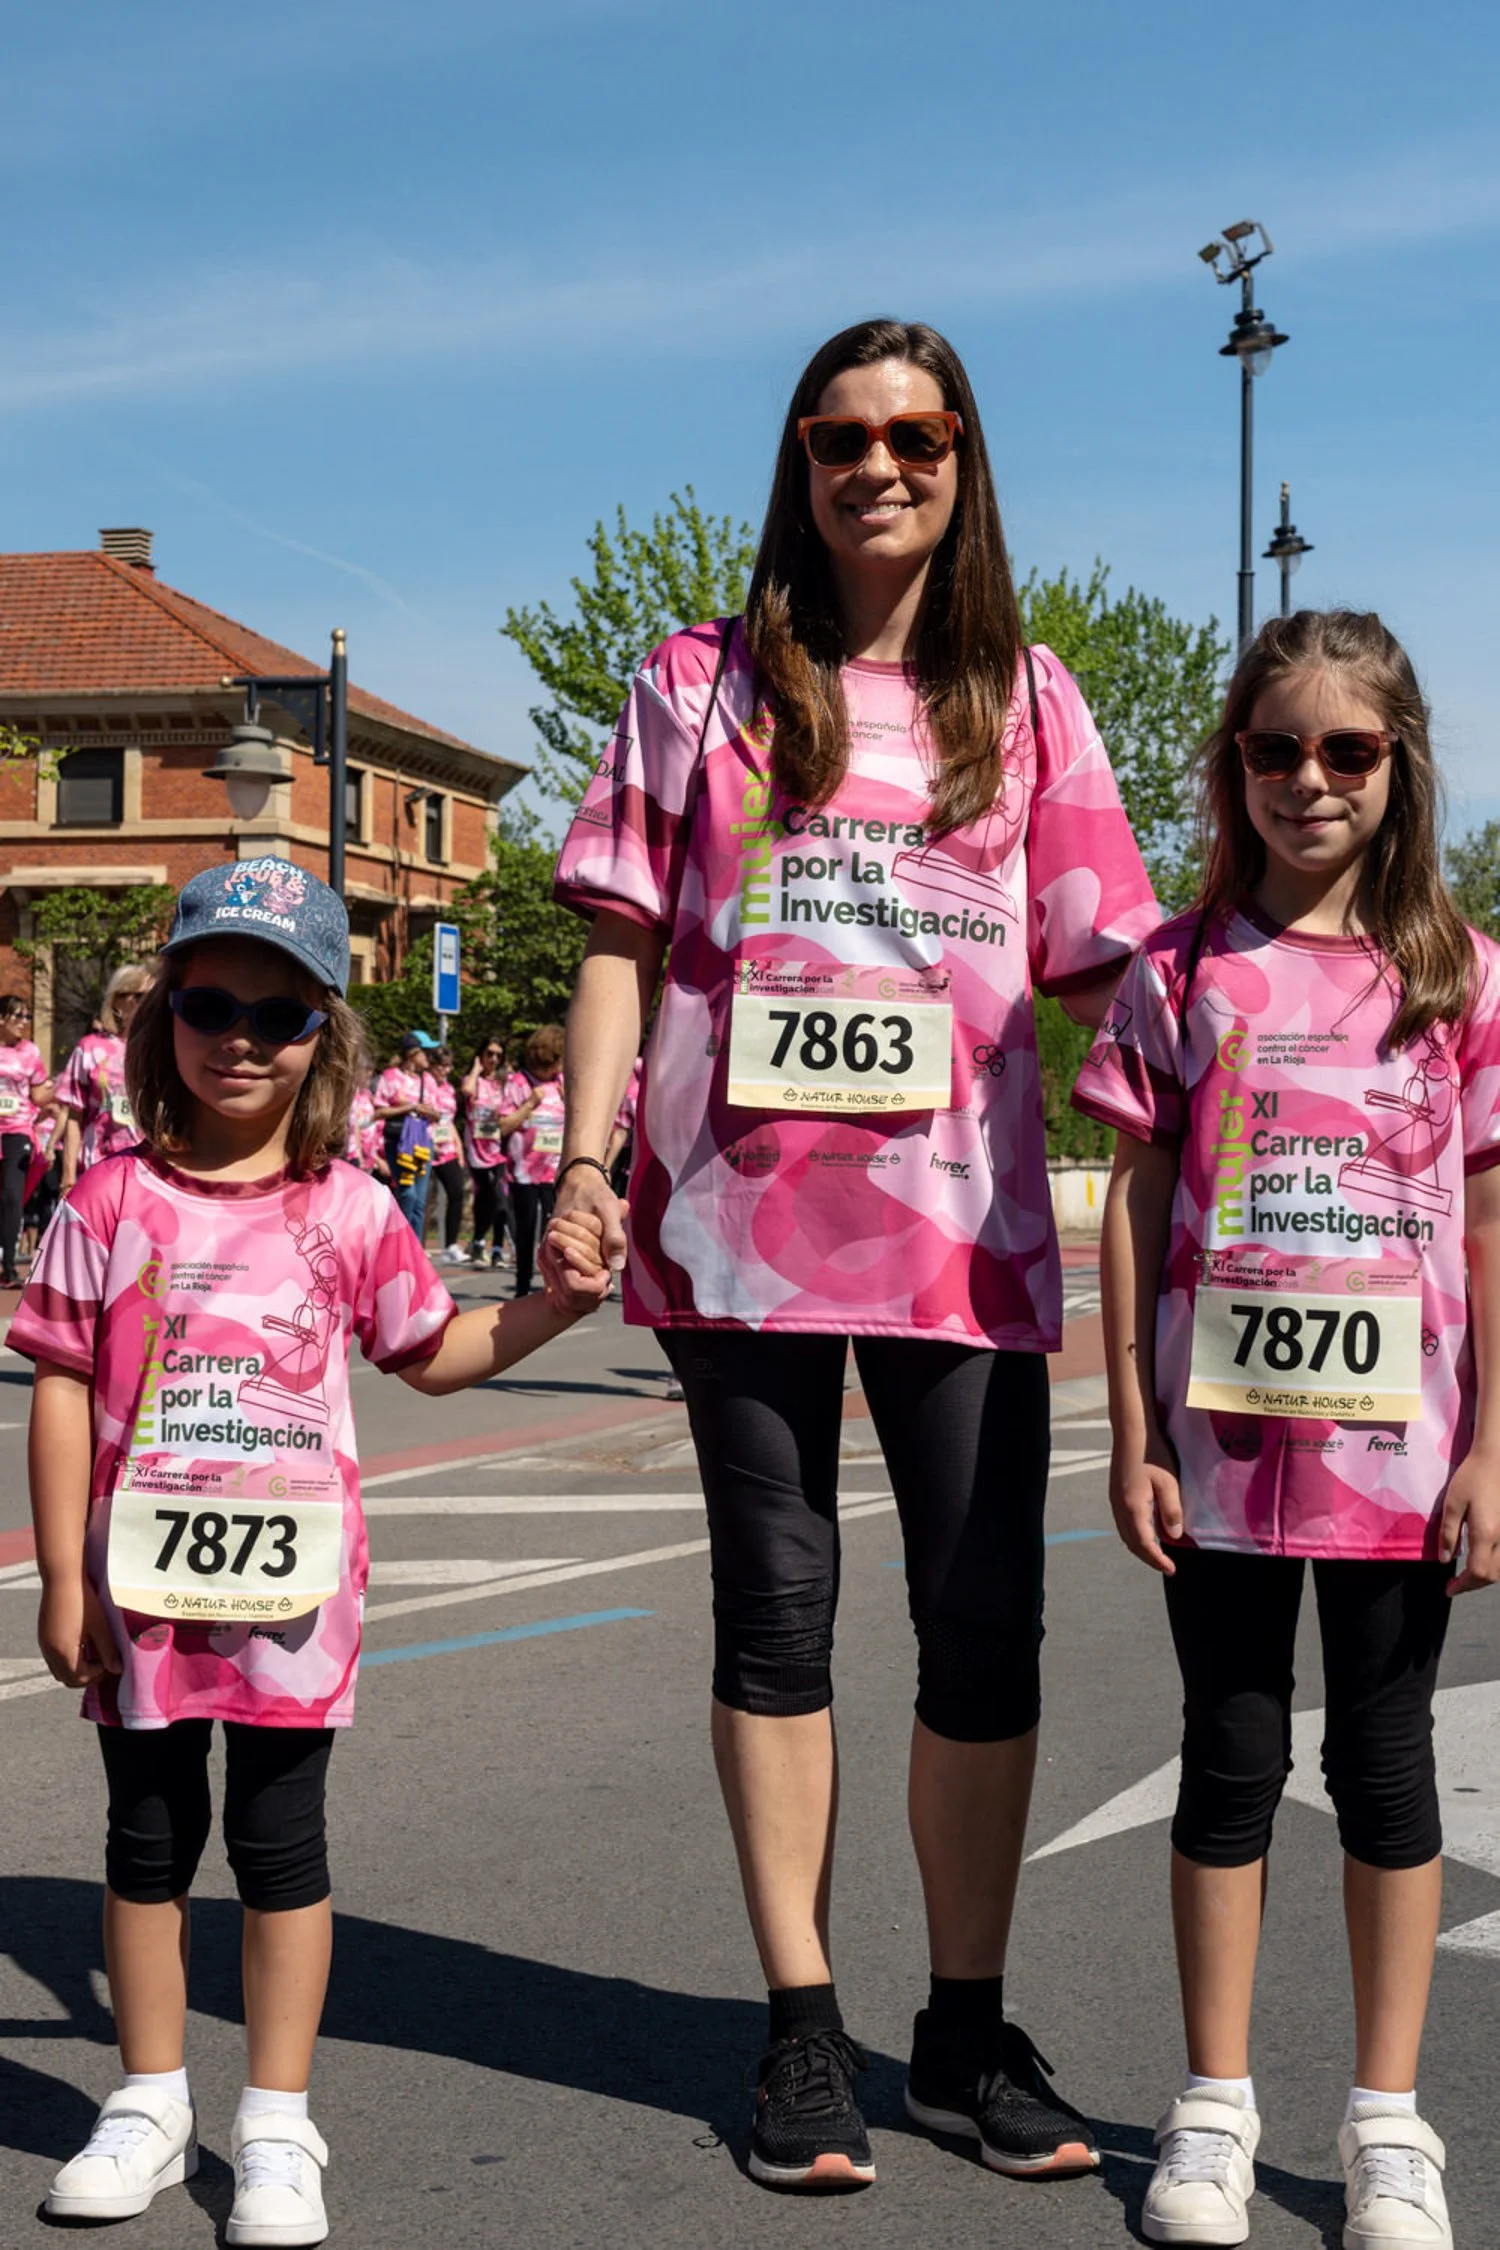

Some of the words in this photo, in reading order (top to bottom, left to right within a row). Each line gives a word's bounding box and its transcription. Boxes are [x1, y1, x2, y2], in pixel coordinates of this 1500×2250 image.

[783, 806, 926, 847] Carrera
[730, 767, 784, 924] mujer
[780, 854, 843, 887] por
[851, 851, 885, 884] la
[216, 906, 240, 919] ICE
[242, 907, 297, 932] CREAM
[780, 891, 1006, 946] Investigación
[766, 973, 803, 983] Carrera
[805, 974, 821, 984] por
[823, 974, 833, 983] la
[768, 1010, 914, 1075] 7863
[1257, 1056, 1269, 1064] en
[1270, 1055, 1281, 1065] La
[1283, 1055, 1306, 1066] Rioja
[800, 1091, 844, 1104] NATUR
[847, 1093, 889, 1105] HOUSE
[1251, 1091, 1278, 1119] XI
[1250, 1130, 1364, 1158] Carrera
[1211, 1089, 1252, 1237] mujer
[1250, 1172, 1298, 1202] por
[1304, 1166, 1333, 1195] la
[1251, 1207, 1434, 1243] Investigación
[1227, 1264, 1264, 1274] Carrera
[1266, 1268, 1284, 1277] por
[181, 1281, 191, 1290] La
[163, 1314, 187, 1340] XI
[1231, 1304, 1381, 1375] 7870
[163, 1349, 261, 1376] Carrera
[161, 1387, 203, 1415] por
[209, 1383, 233, 1408] la
[1263, 1393, 1309, 1407] NATUR
[1312, 1396, 1357, 1410] HOUSE
[161, 1418, 322, 1451] Investigación
[150, 1469, 190, 1480] Carrera
[191, 1473, 209, 1482] por
[211, 1473, 223, 1482] la
[154, 1509, 298, 1578] 7873
[181, 1597, 227, 1609] NATUR
[231, 1599, 275, 1612] HOUSE
